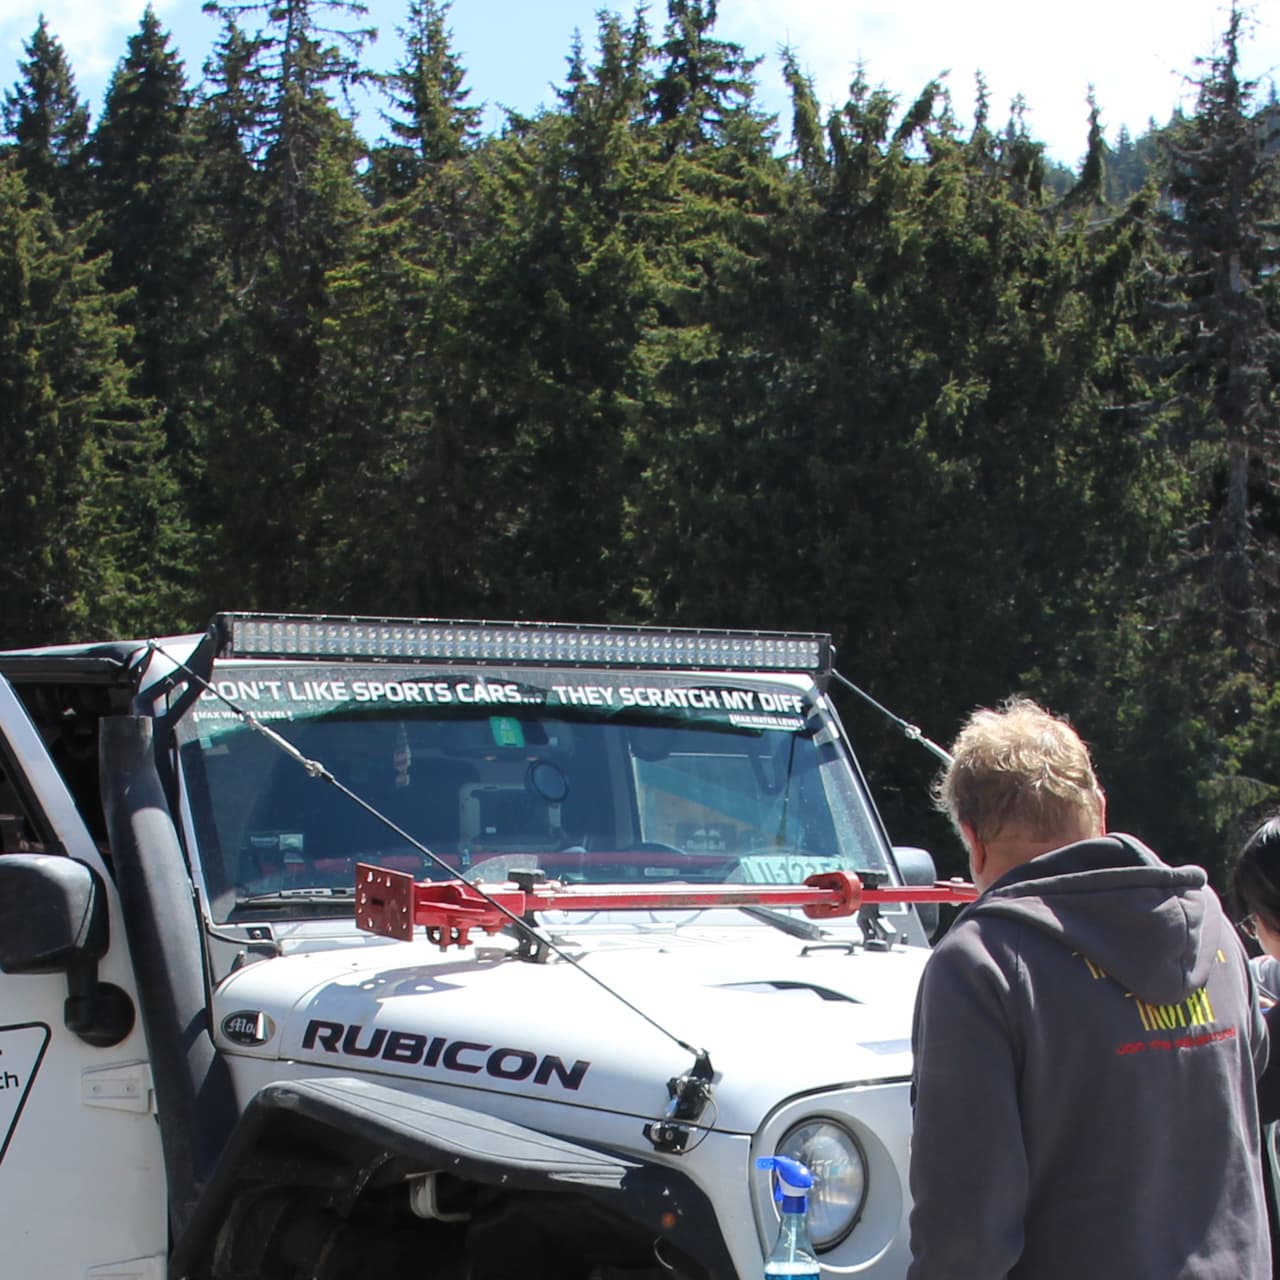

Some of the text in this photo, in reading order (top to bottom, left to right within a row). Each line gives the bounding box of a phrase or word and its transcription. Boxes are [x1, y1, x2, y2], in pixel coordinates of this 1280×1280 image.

[288, 681, 347, 702] LIKE
[352, 682, 451, 703] SPORTS
[455, 683, 542, 704] CARS...
[552, 685, 615, 706] THEY
[620, 687, 720, 710] SCRATCH
[721, 692, 754, 711] MY
[758, 693, 803, 714] DIFF
[302, 1019, 591, 1091] RUBICON
